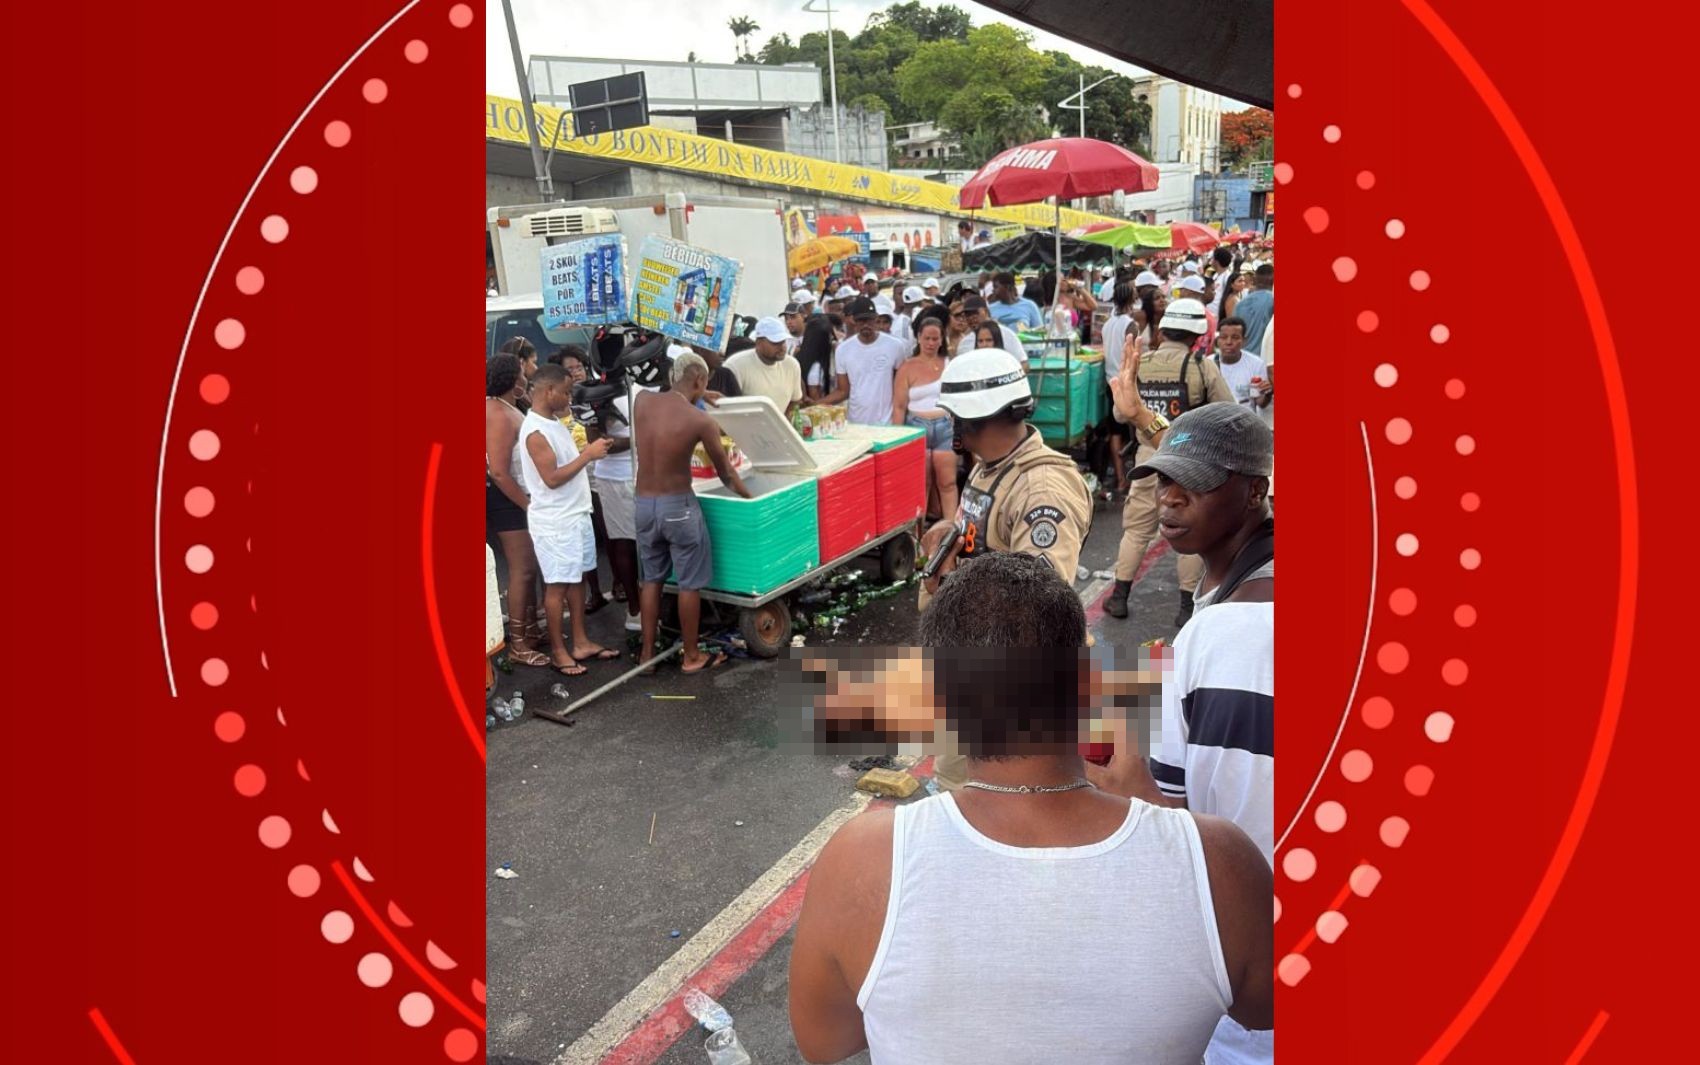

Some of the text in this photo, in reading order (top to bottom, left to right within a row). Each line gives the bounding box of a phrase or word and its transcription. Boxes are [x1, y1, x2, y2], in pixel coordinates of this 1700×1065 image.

[612, 130, 708, 164] BONFIM
[718, 146, 745, 171] DA
[753, 153, 813, 182] BAHIA
[977, 147, 1058, 181] HMA
[549, 255, 578, 271] 2 SKOL
[663, 244, 712, 271] BEBIDAS
[552, 271, 578, 286] BEATS
[591, 257, 600, 302] BEATS
[604, 249, 613, 294] BEATS
[557, 289, 575, 301] POR
[1170, 399, 1181, 416] C
